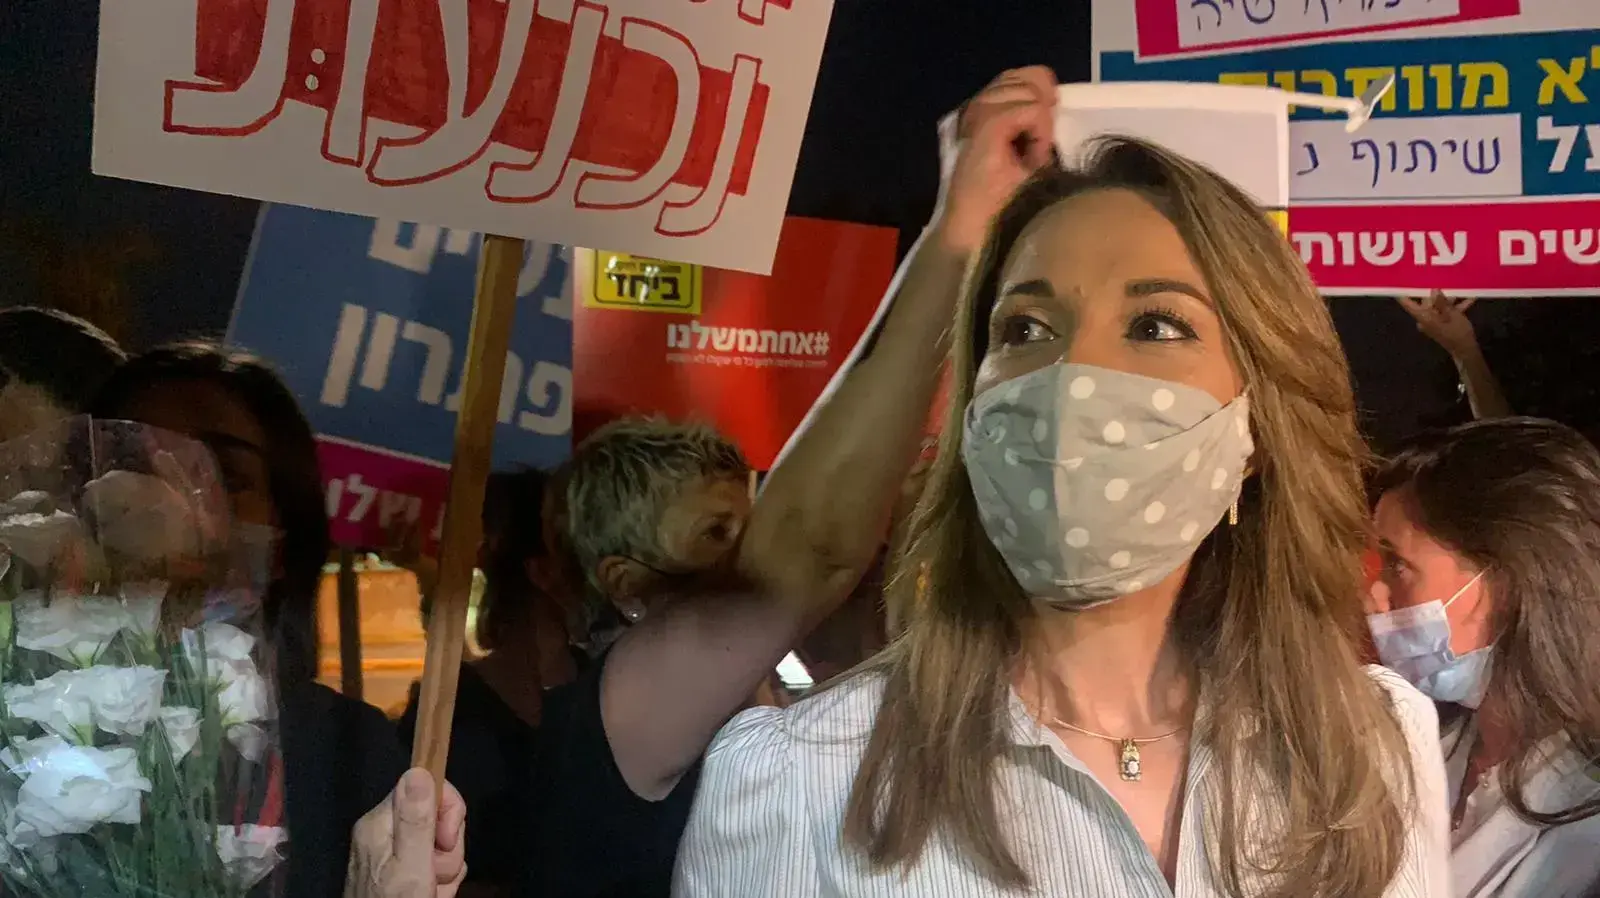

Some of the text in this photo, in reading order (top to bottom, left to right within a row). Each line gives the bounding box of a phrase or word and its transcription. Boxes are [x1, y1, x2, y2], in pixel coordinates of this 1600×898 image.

[1351, 137, 1500, 189] שיתוף
[1291, 229, 1468, 267] עושות
[606, 272, 681, 302] ביחד
[666, 320, 829, 356] #אחתמשלנו
